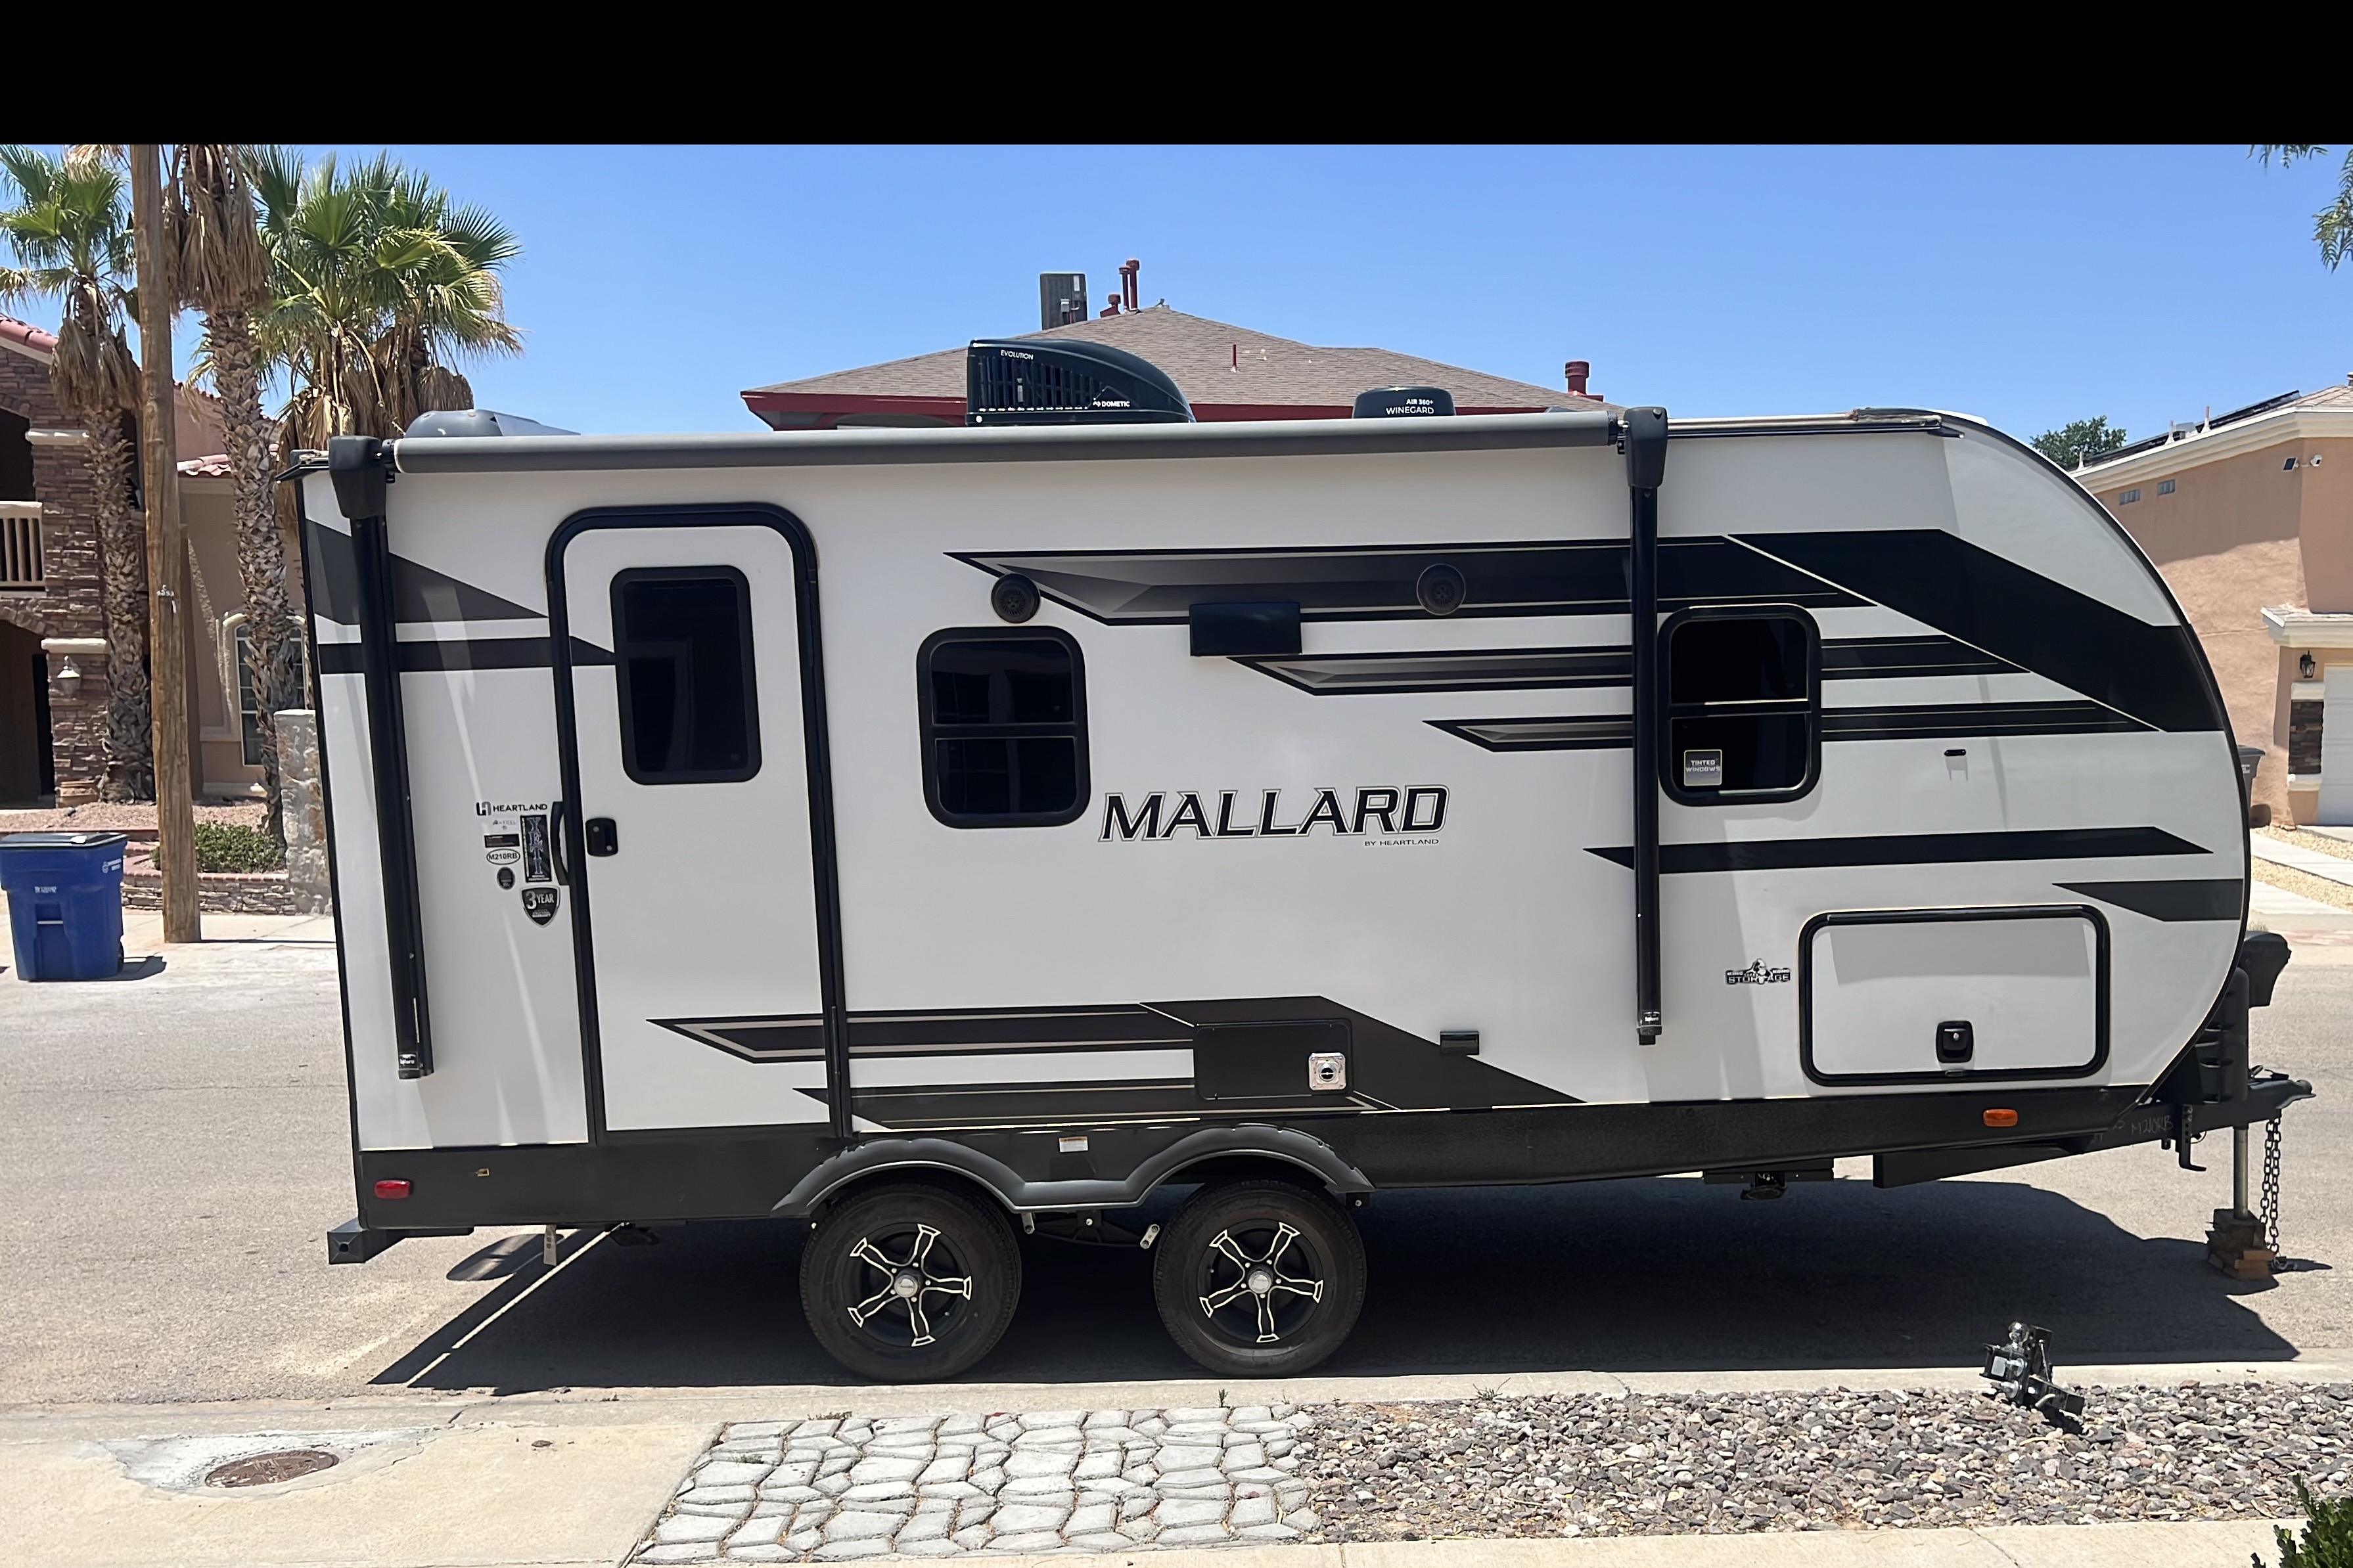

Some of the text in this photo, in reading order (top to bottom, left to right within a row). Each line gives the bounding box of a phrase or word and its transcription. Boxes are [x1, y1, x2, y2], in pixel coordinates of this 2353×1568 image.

[1001, 349, 1034, 360] EVOLUTION
[1386, 406, 1434, 415] WINEGARD
[493, 803, 548, 812] HEARTLAND
[1098, 784, 1450, 842] MALLARD
[526, 890, 555, 910] 3 YEAR
